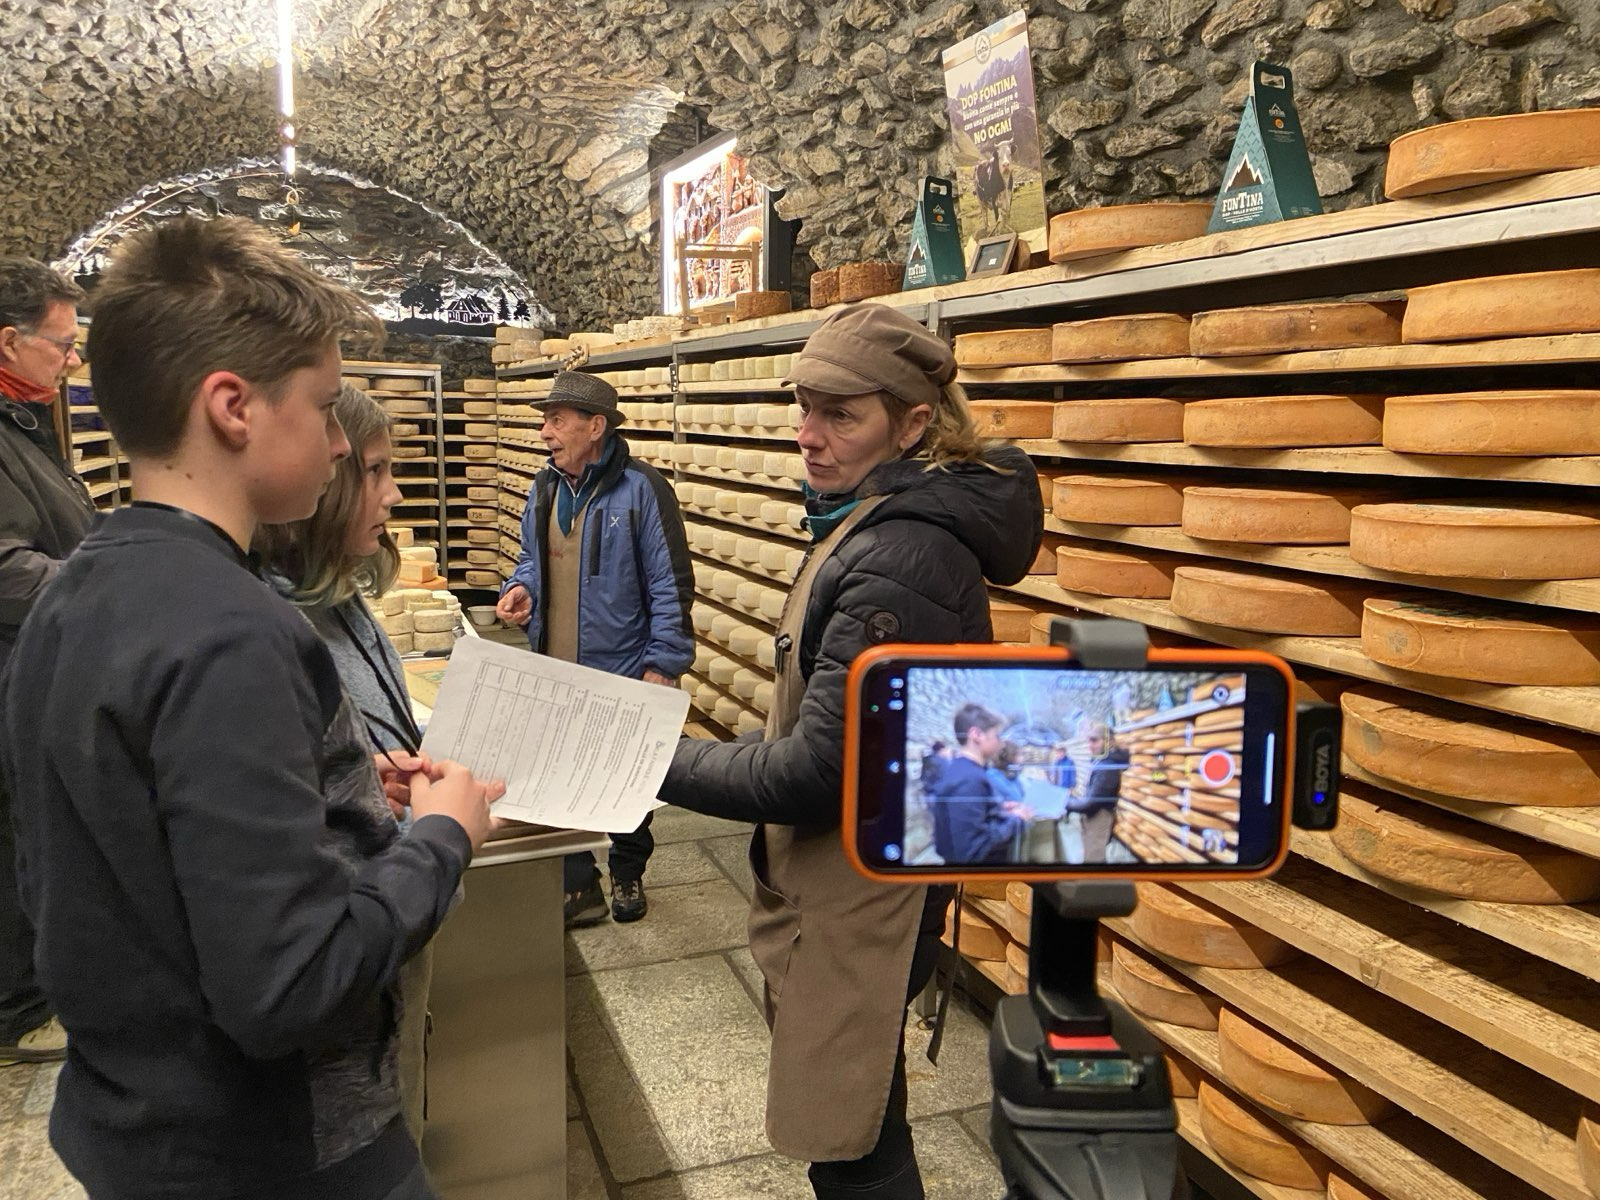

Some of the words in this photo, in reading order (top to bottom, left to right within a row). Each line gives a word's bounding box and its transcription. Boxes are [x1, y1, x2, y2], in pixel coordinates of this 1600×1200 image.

[960, 91, 978, 110] DOP
[980, 75, 1017, 102] FONTINA
[994, 95, 1014, 108] sempre
[973, 128, 987, 145] NO
[988, 117, 1012, 139] OGM!
[1314, 744, 1331, 792] BOYA
